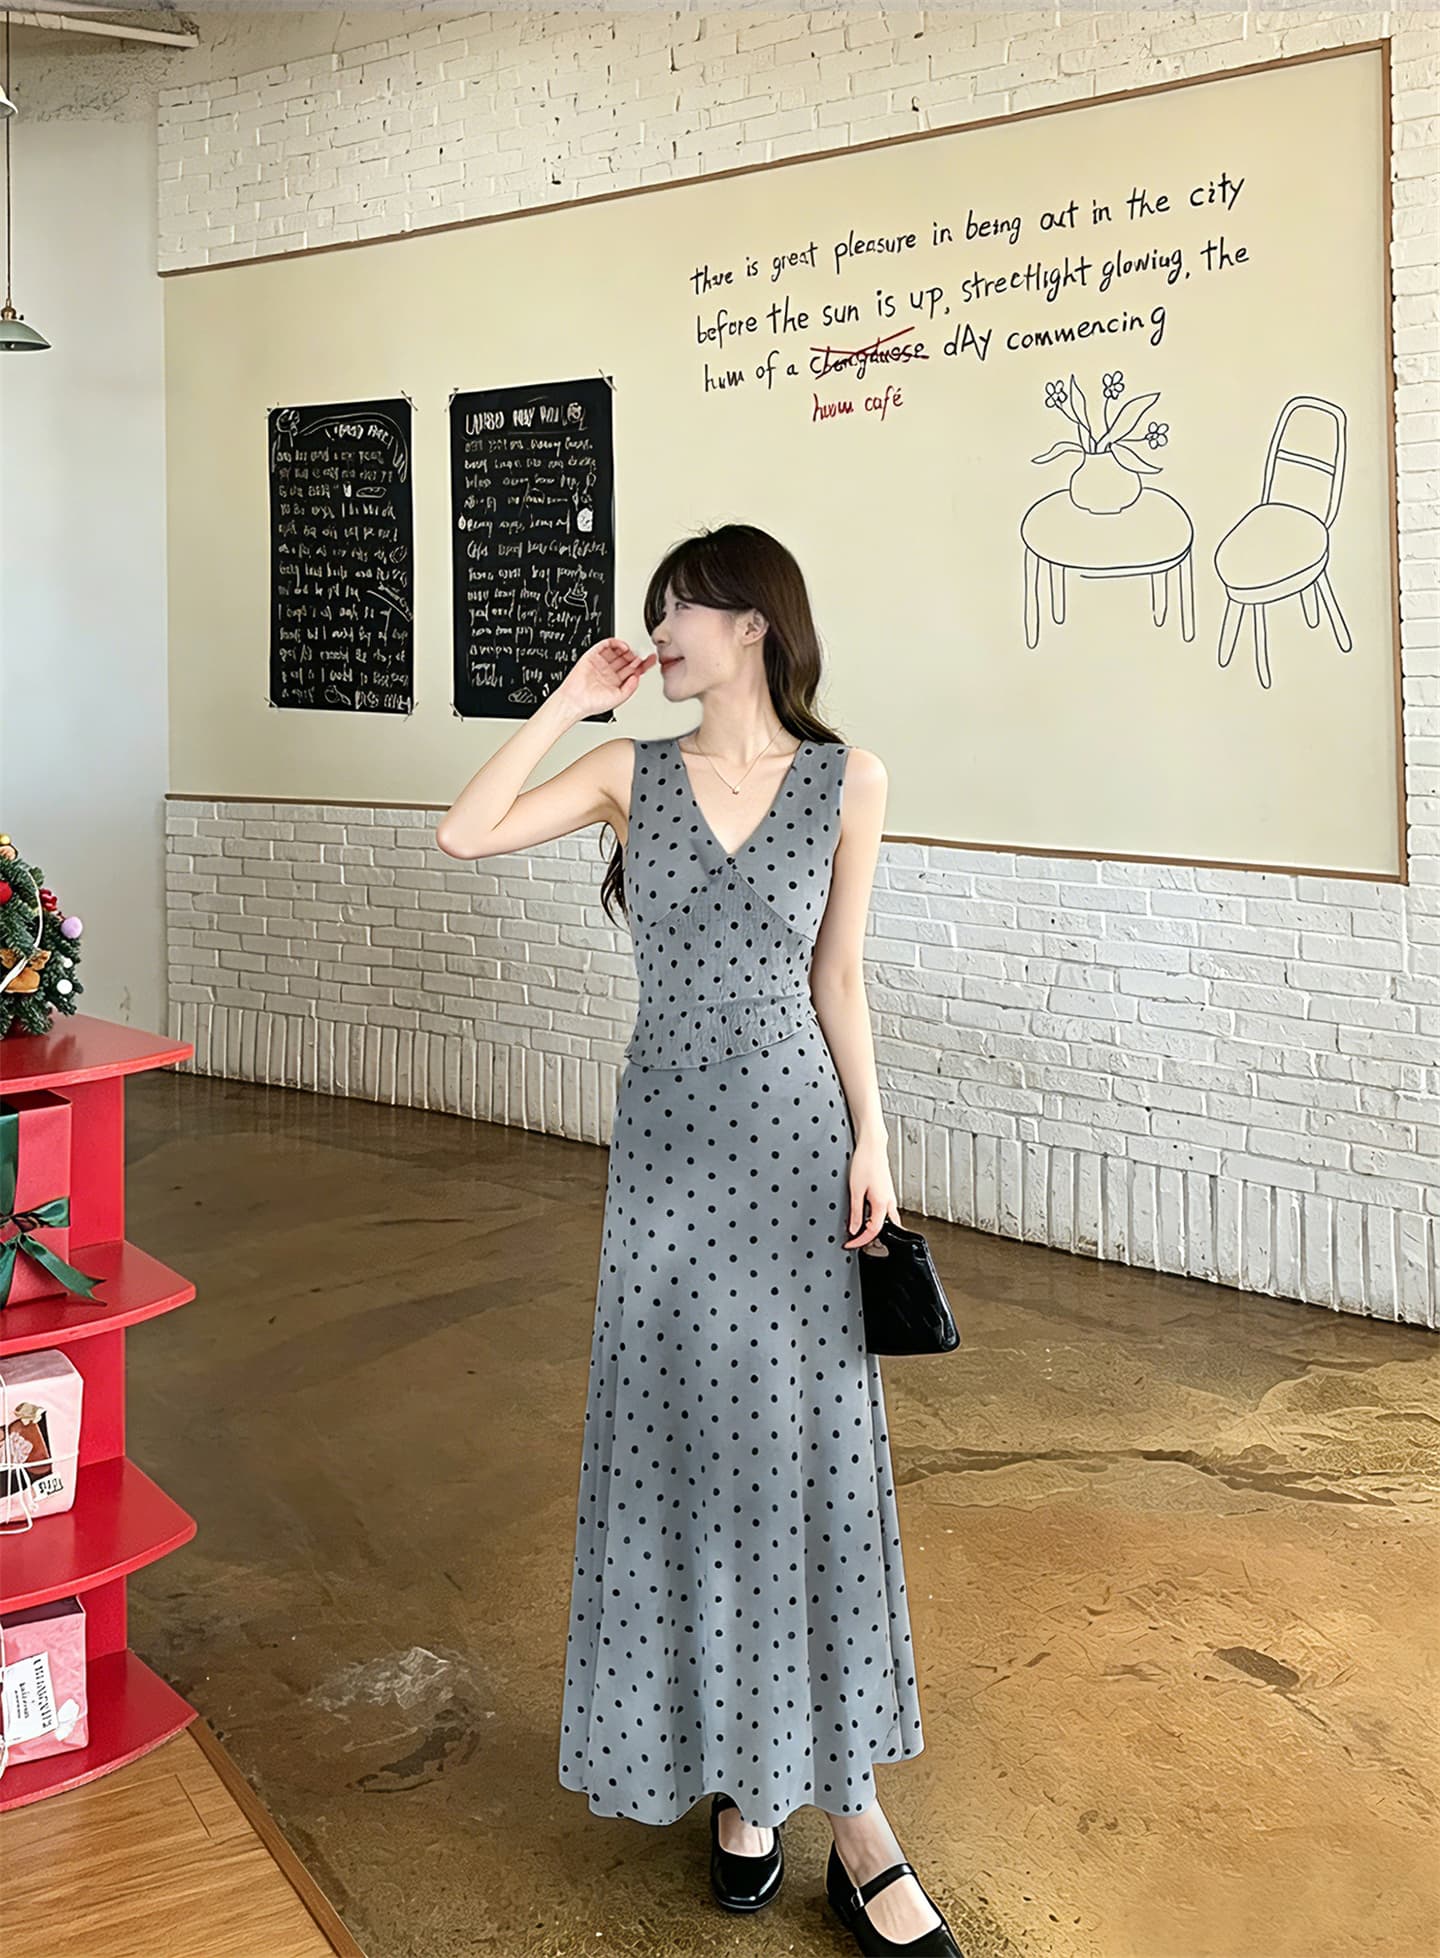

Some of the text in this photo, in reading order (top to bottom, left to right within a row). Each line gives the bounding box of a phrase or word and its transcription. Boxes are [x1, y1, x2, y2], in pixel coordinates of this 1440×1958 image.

[745, 256, 759, 277] is
[771, 241, 819, 283] great
[834, 229, 917, 275] pleasure
[932, 221, 953, 246] in
[965, 205, 1022, 245] being
[1092, 199, 1112, 225] in
[1126, 187, 1171, 220] the
[1189, 172, 1245, 211] city
[697, 309, 758, 349] before
[766, 295, 809, 334] the
[822, 304, 860, 327] sun
[876, 289, 896, 318] is
[1199, 236, 1250, 271] the
[755, 350, 780, 390] of
[786, 363, 799, 377] a
[1006, 306, 1167, 347] commencing
[864, 385, 904, 421] café
